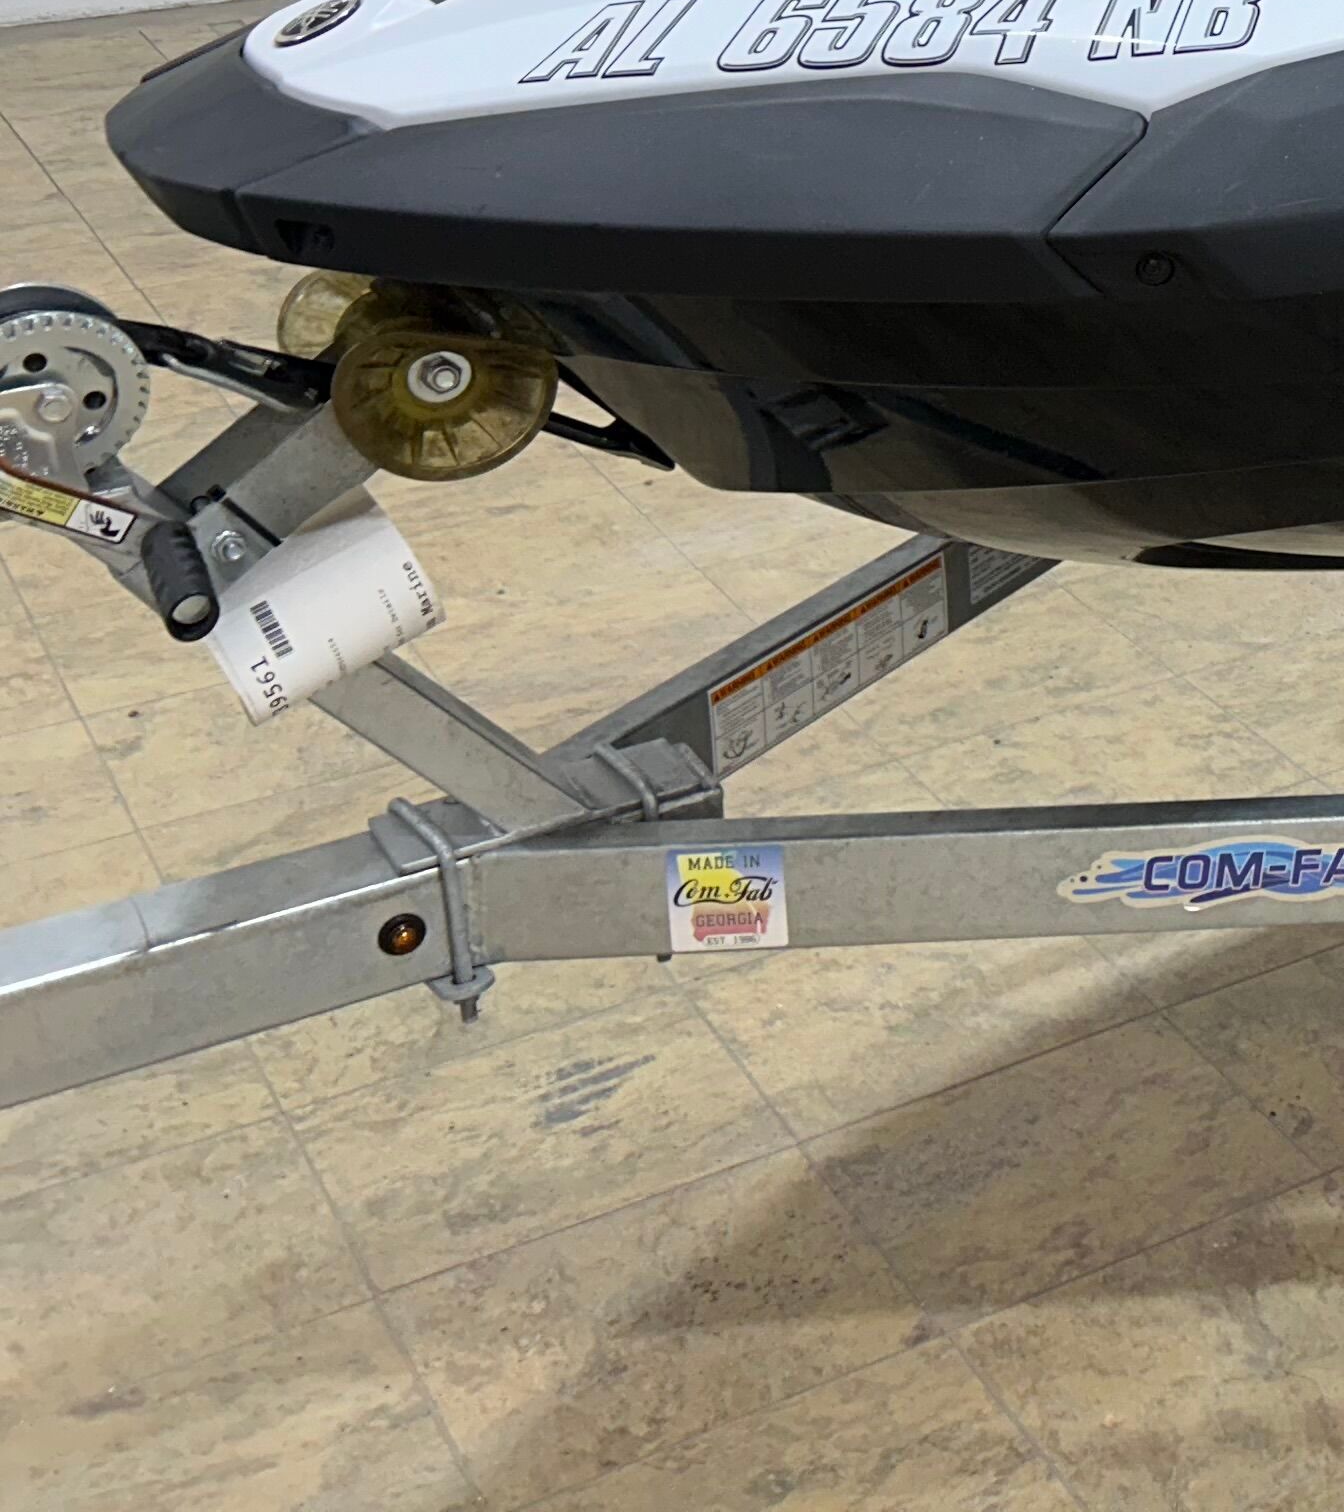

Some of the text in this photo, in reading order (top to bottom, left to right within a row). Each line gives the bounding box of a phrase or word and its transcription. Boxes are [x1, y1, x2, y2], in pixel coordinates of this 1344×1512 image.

[402, 560, 434, 617] Marine
[687, 854, 760, 870] MADE IN
[695, 911, 764, 928] GEORGIA
